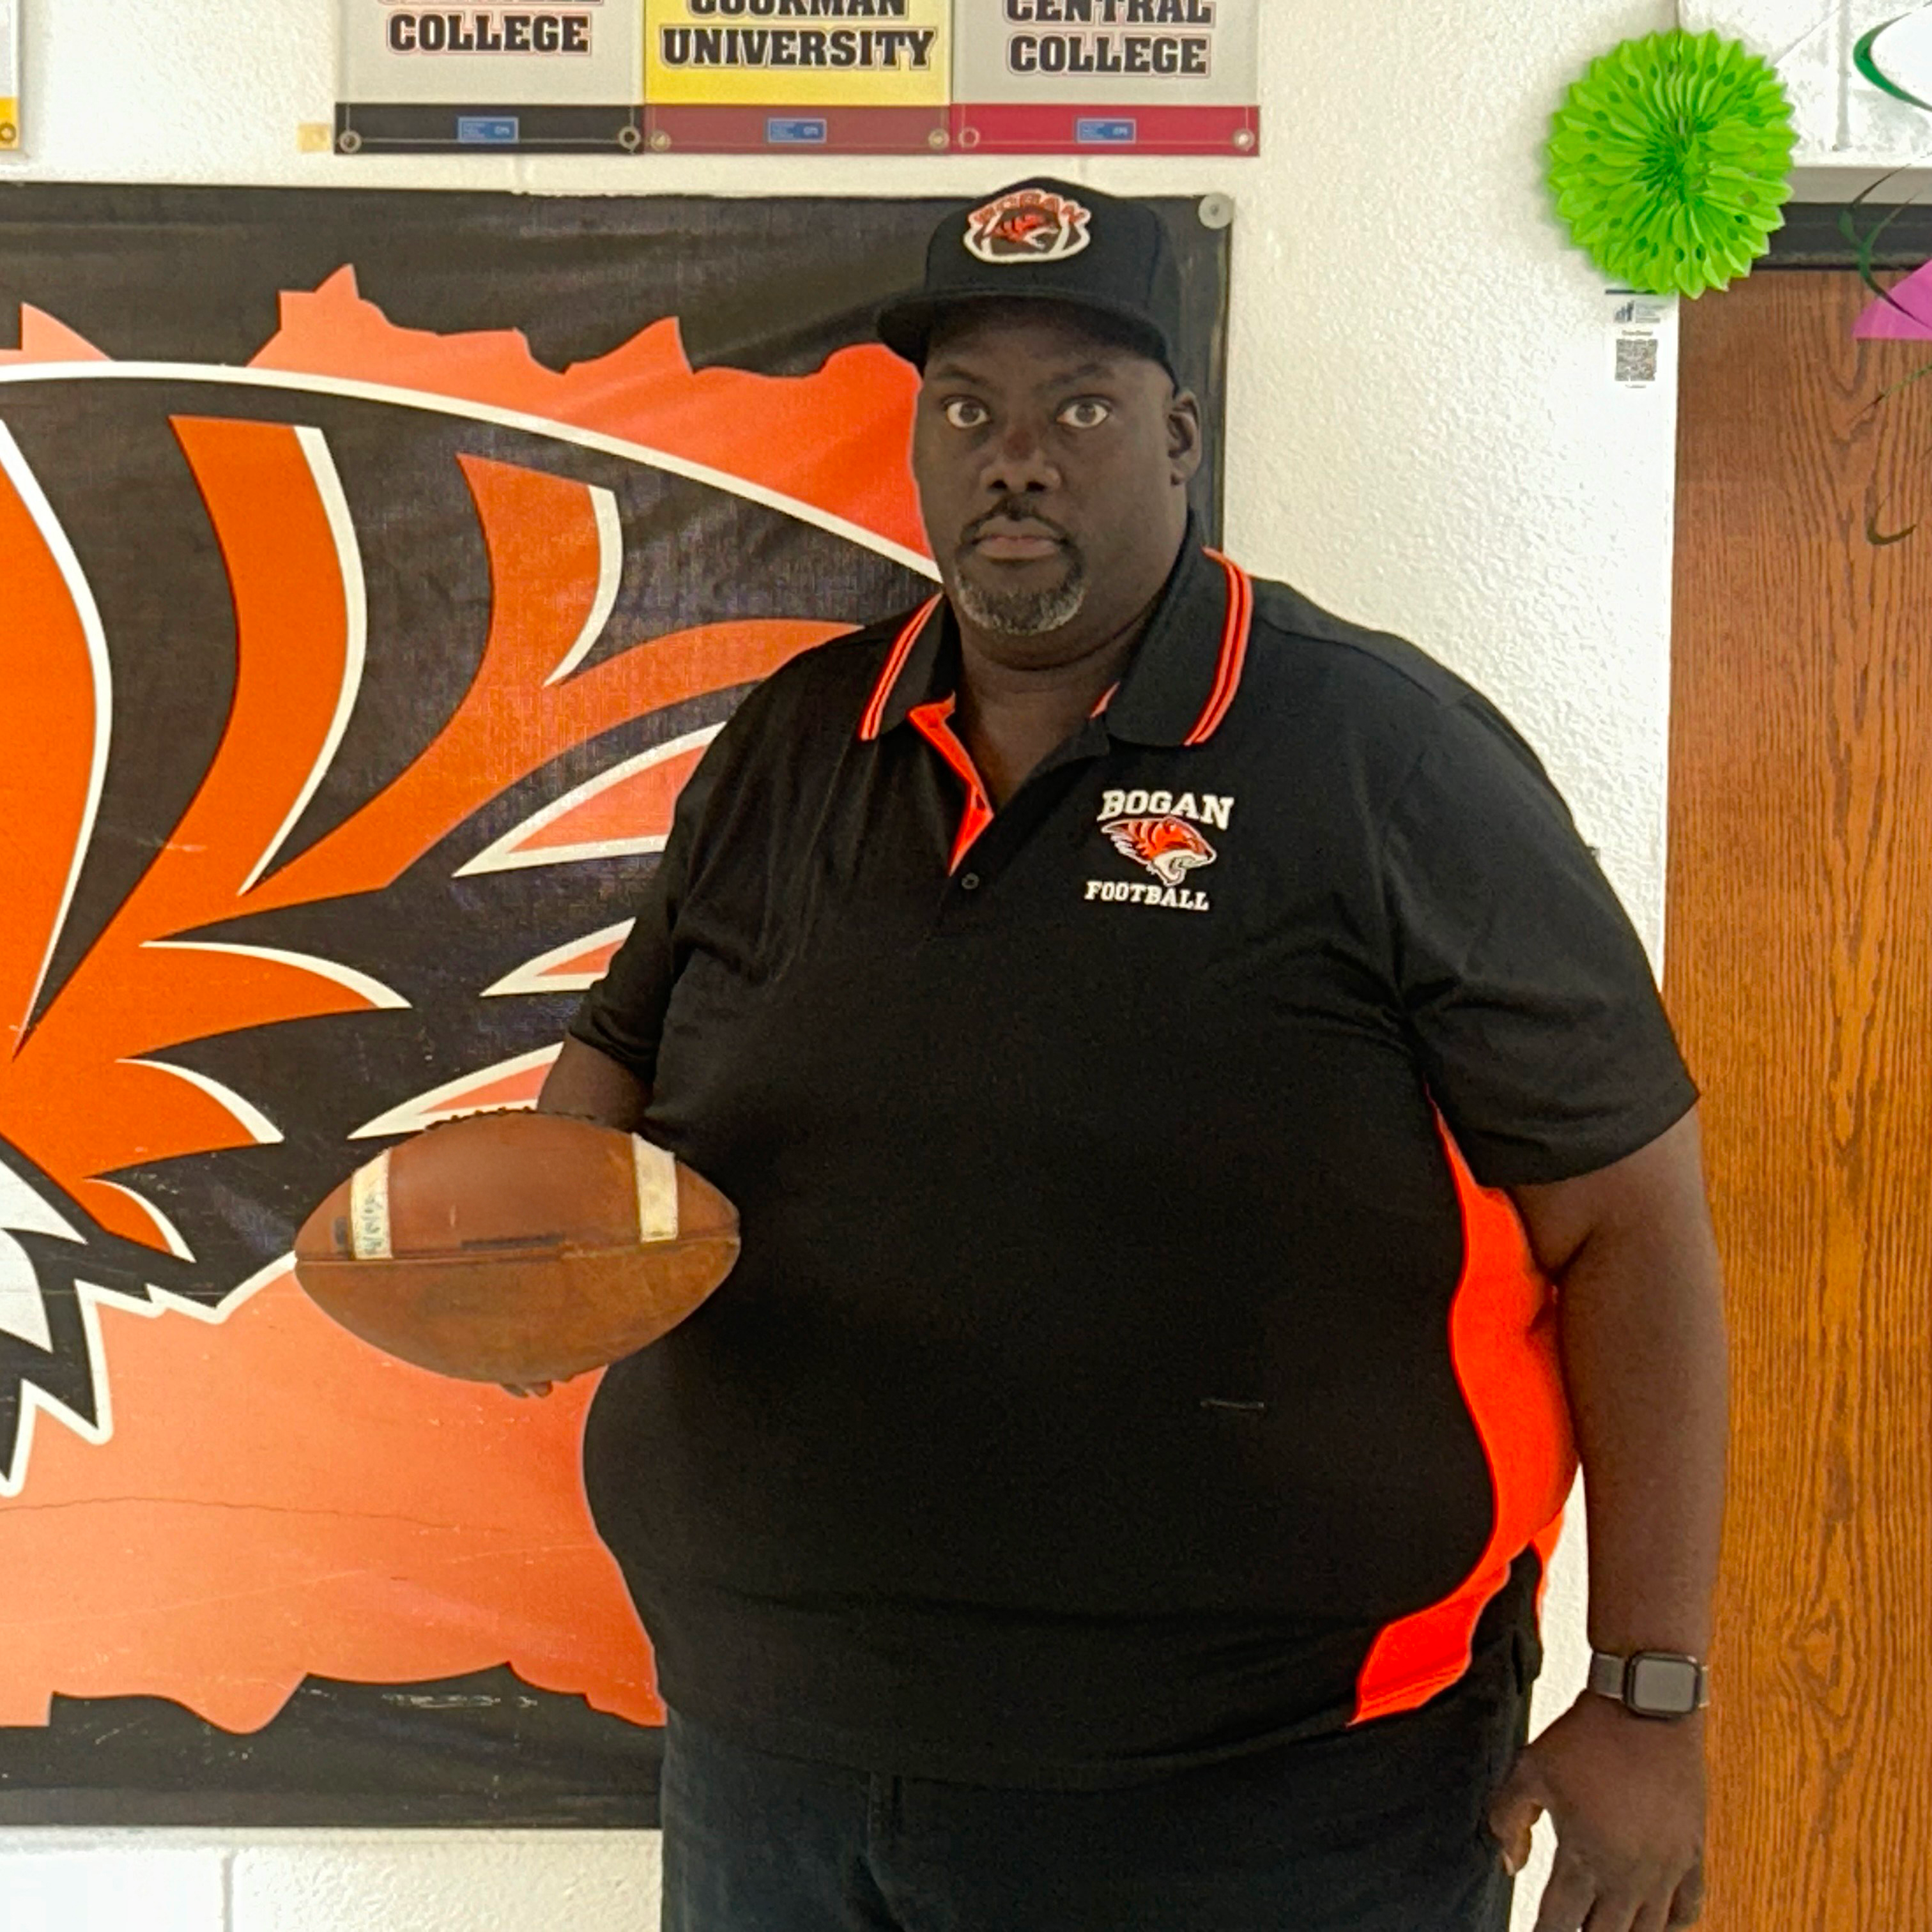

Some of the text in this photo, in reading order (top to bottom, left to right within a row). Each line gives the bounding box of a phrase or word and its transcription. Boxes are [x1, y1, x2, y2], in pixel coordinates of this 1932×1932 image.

[1007, 0, 1211, 23] CENTRAL
[390, 14, 588, 52] COLLEGE
[663, 29, 935, 66] UNIVERSITY
[1010, 35, 1208, 73] COLLEGE
[1096, 790, 1234, 831] BOGAN
[1084, 880, 1209, 911] FOOTBALL
